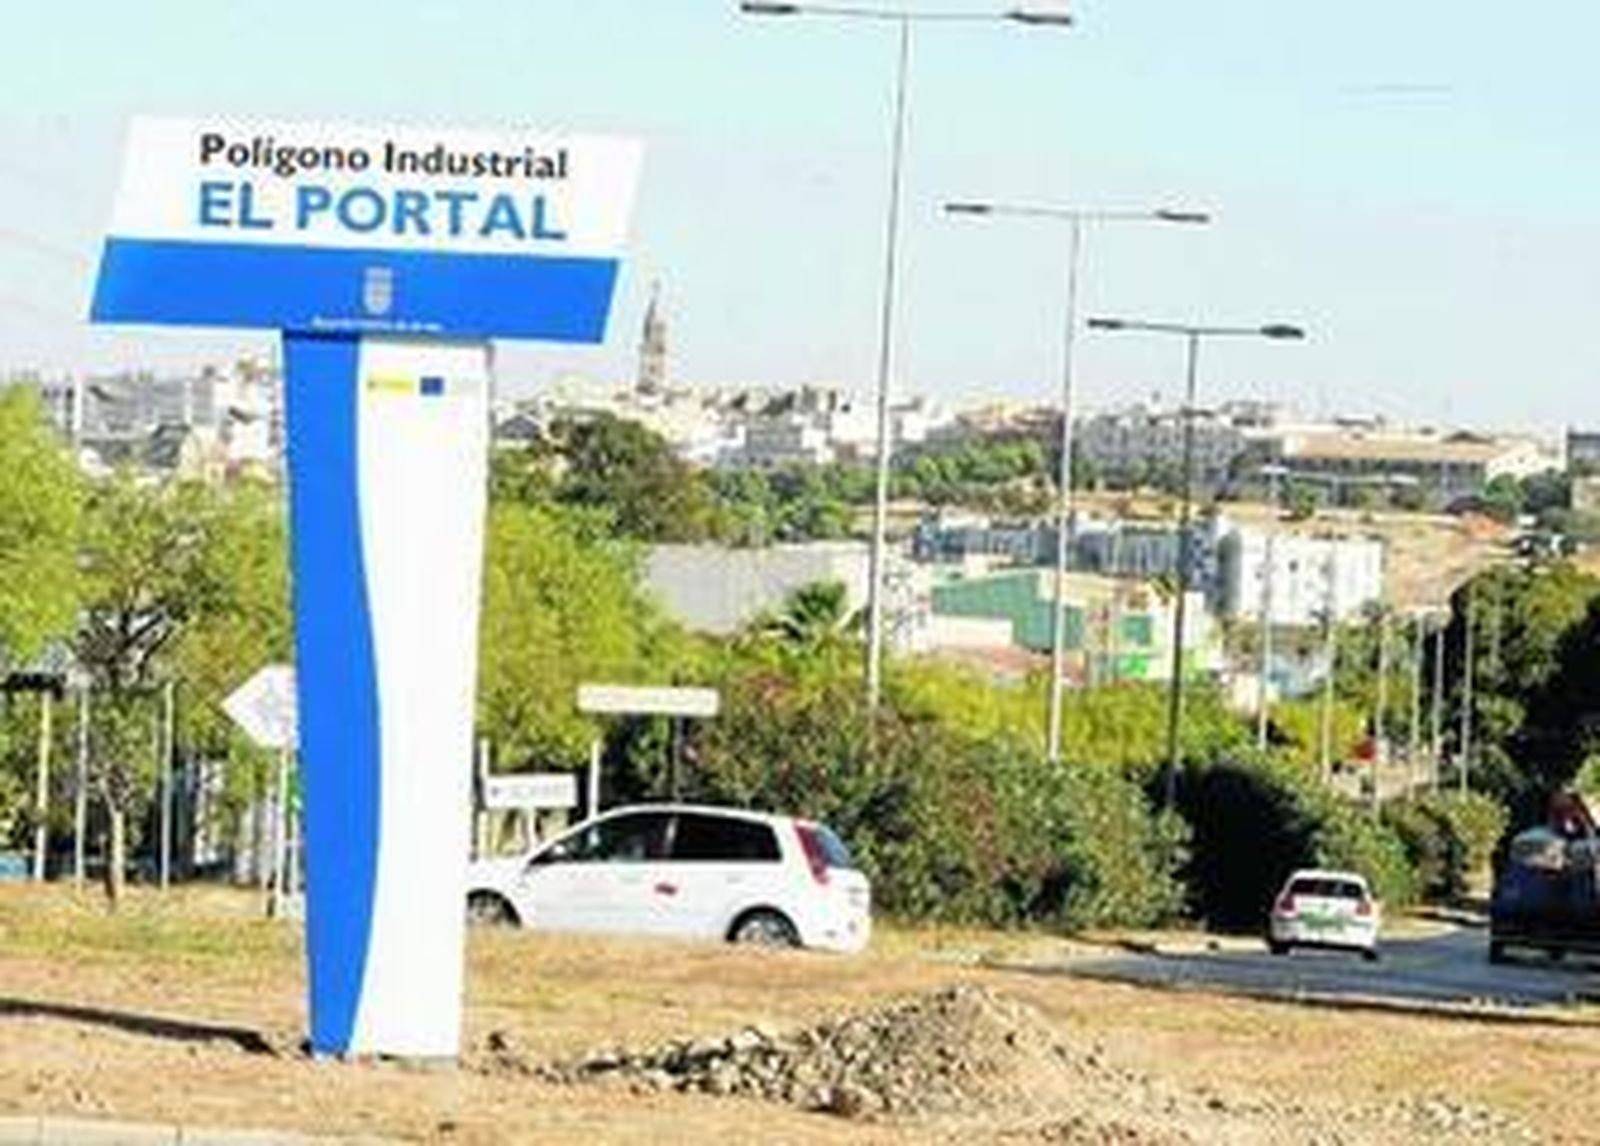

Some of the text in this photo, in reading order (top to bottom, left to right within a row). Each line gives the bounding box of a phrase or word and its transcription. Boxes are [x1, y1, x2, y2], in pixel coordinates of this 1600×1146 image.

[384, 140, 568, 179] Industrial
[200, 181, 567, 241] EL PORTAL
